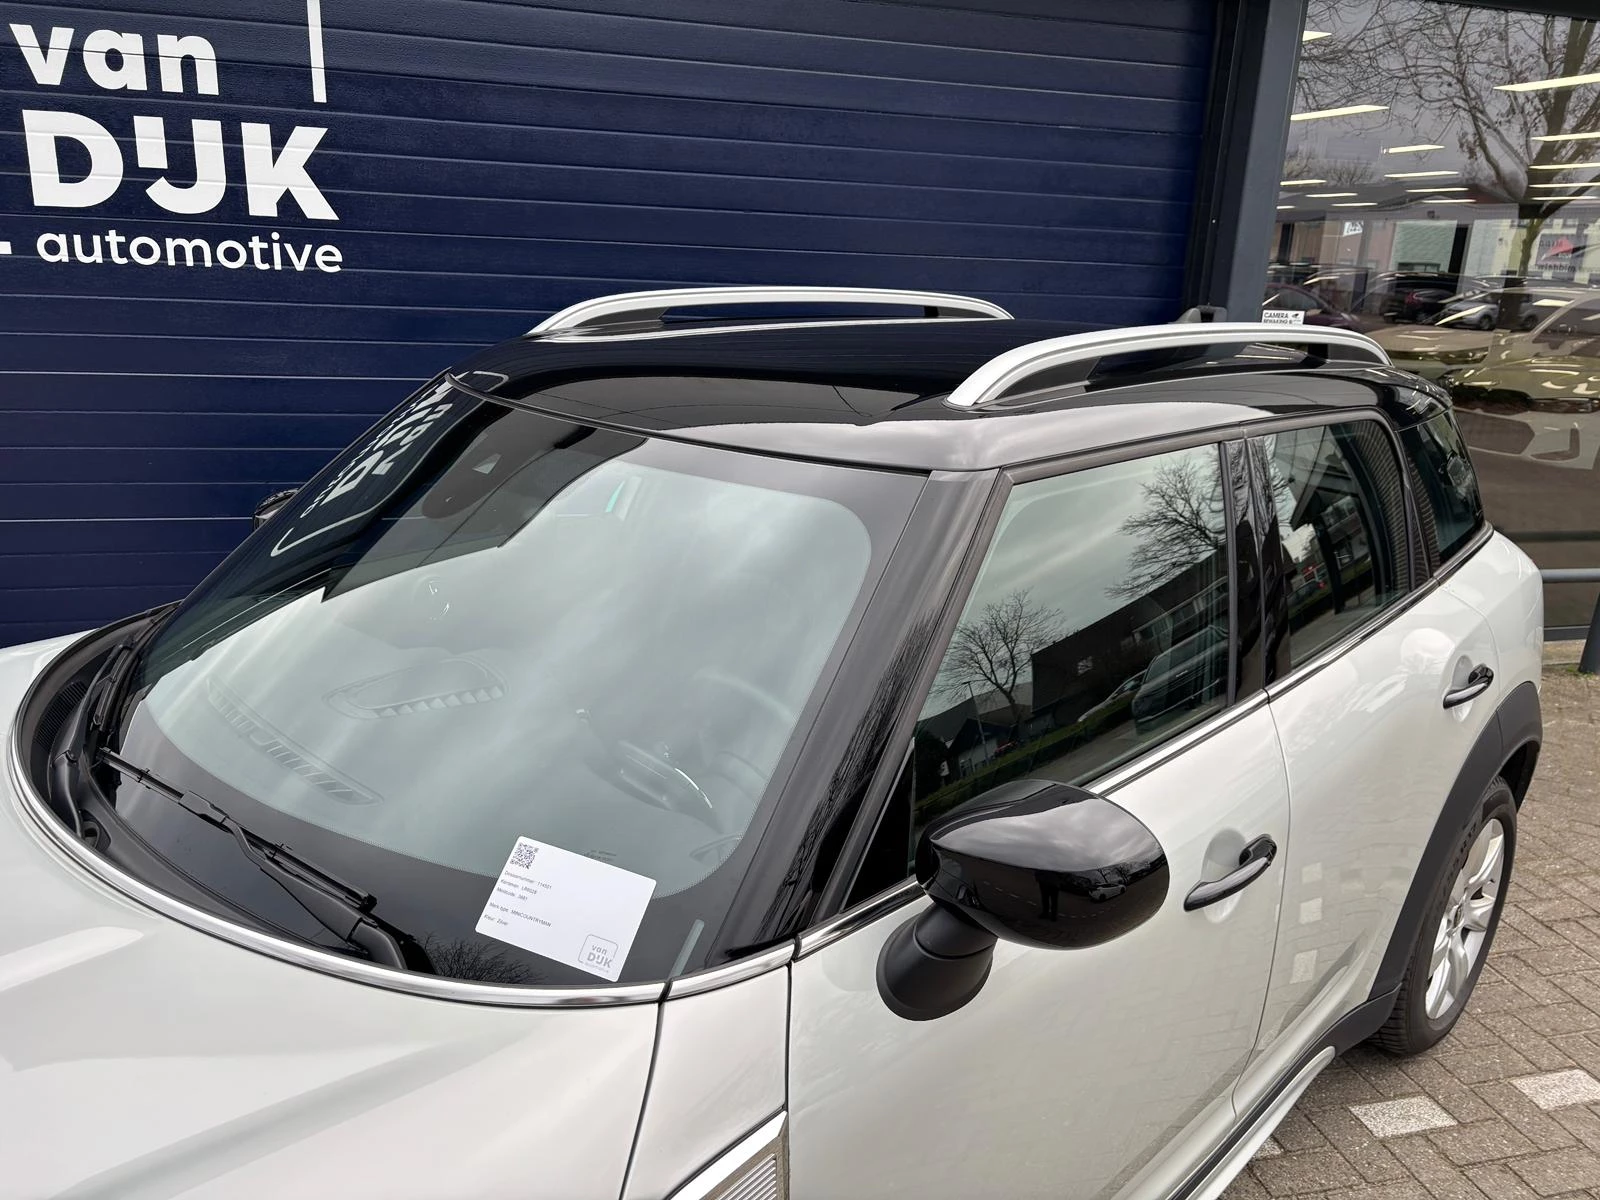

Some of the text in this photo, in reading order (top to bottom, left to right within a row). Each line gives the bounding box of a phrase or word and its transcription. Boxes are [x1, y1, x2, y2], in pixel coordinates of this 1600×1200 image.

[9, 23, 219, 96] van
[22, 109, 340, 221] DIJK
[36, 228, 343, 273] automotive
[587, 951, 612, 968] DIJK
[592, 945, 608, 955] van
